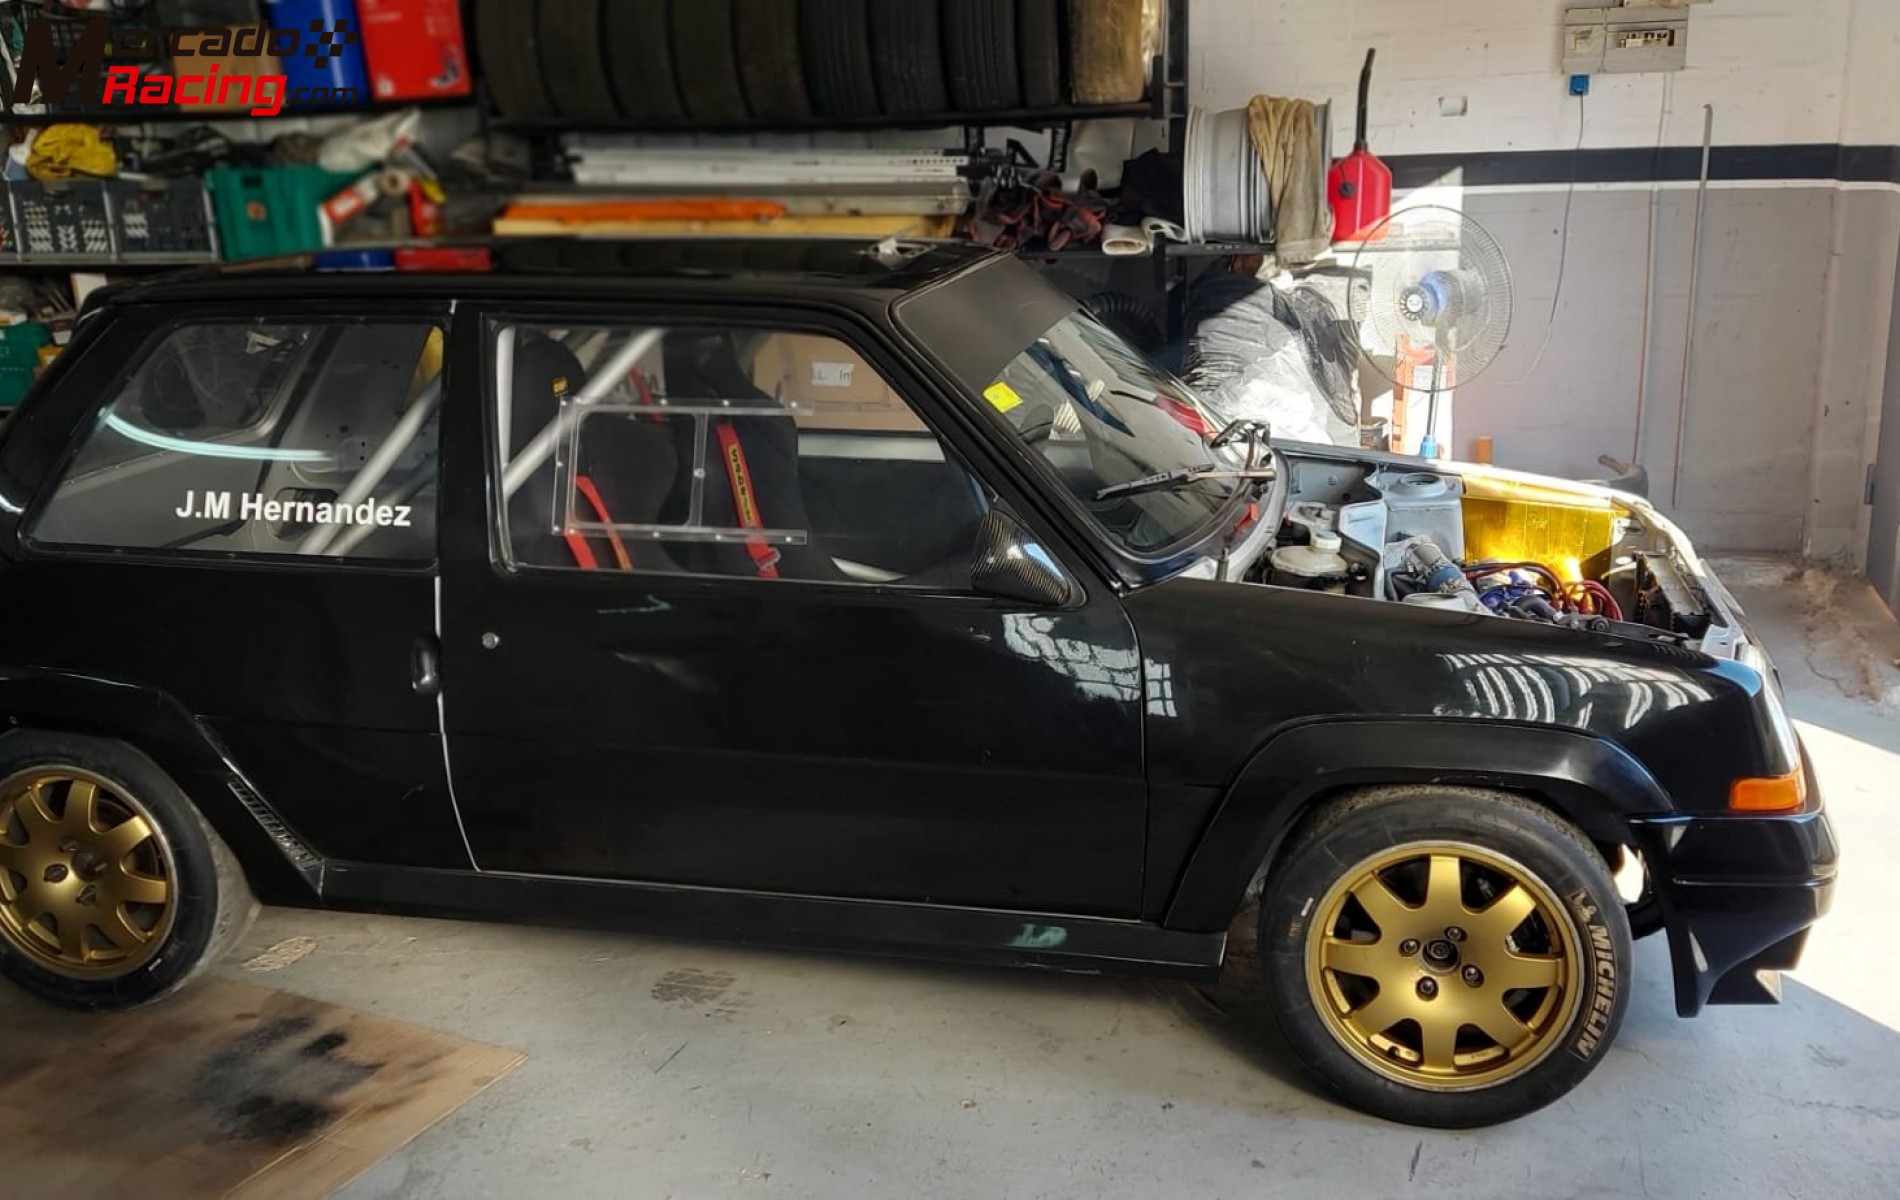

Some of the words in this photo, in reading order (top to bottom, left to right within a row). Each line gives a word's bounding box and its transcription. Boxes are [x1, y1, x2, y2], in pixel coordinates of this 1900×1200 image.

[175, 490, 230, 519] J.M
[240, 493, 411, 526] Hernandez
[1577, 925, 1615, 1057] MICHELIN
